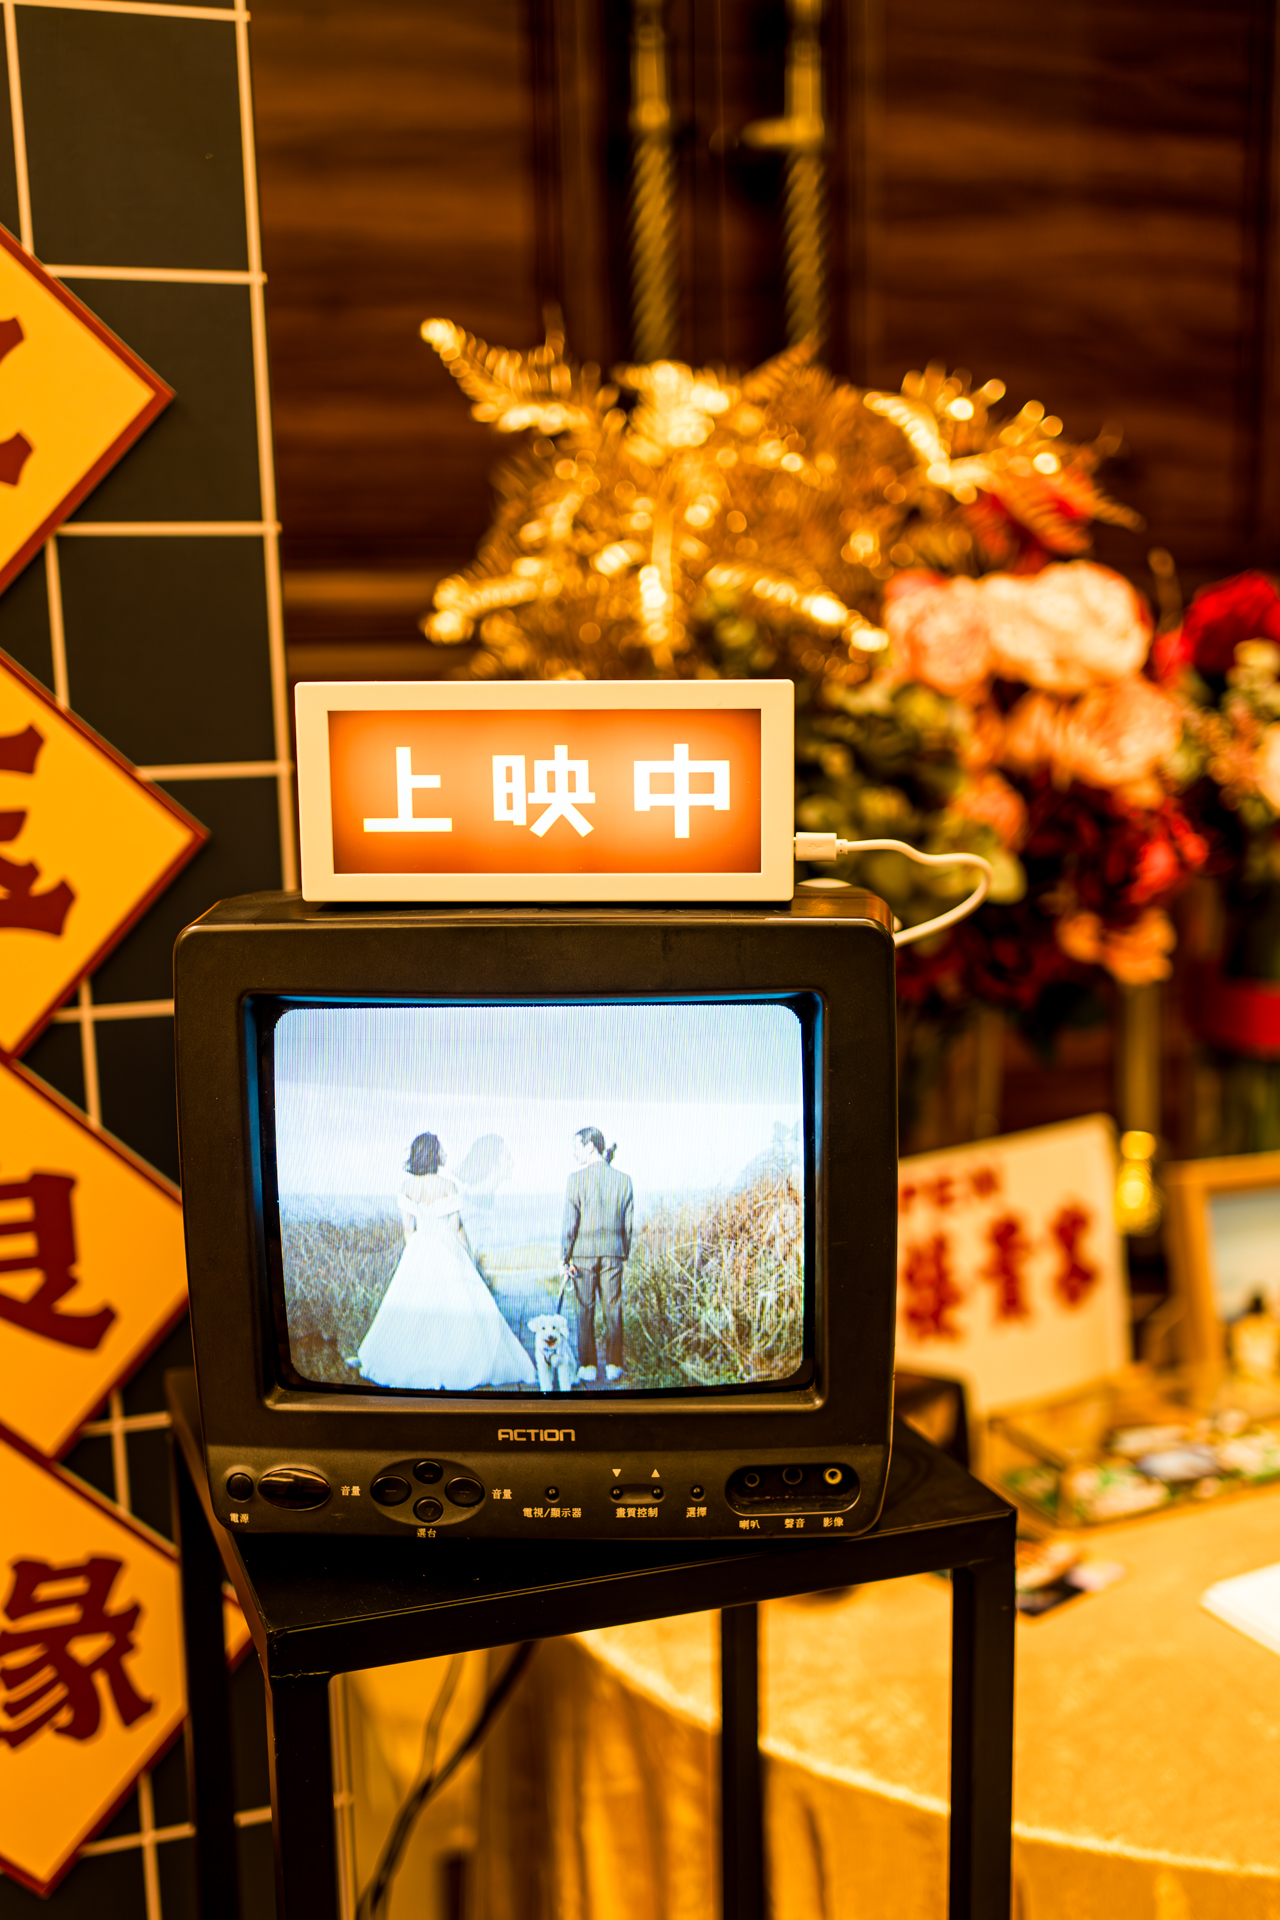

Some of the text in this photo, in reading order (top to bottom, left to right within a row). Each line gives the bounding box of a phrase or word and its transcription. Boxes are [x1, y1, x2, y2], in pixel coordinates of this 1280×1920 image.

[363, 743, 731, 839] 上映中
[497, 1428, 577, 1442] ACTION
[340, 1485, 361, 1497] 音量
[491, 1488, 513, 1500] 音量
[229, 1512, 250, 1524] 電源
[522, 1507, 582, 1518] 電視/顯示器
[686, 1506, 707, 1518] 選擇
[738, 1519, 761, 1530] 喇叭
[784, 1517, 806, 1529] 聲音
[822, 1516, 844, 1528] 影像
[416, 1527, 437, 1539] 選台
